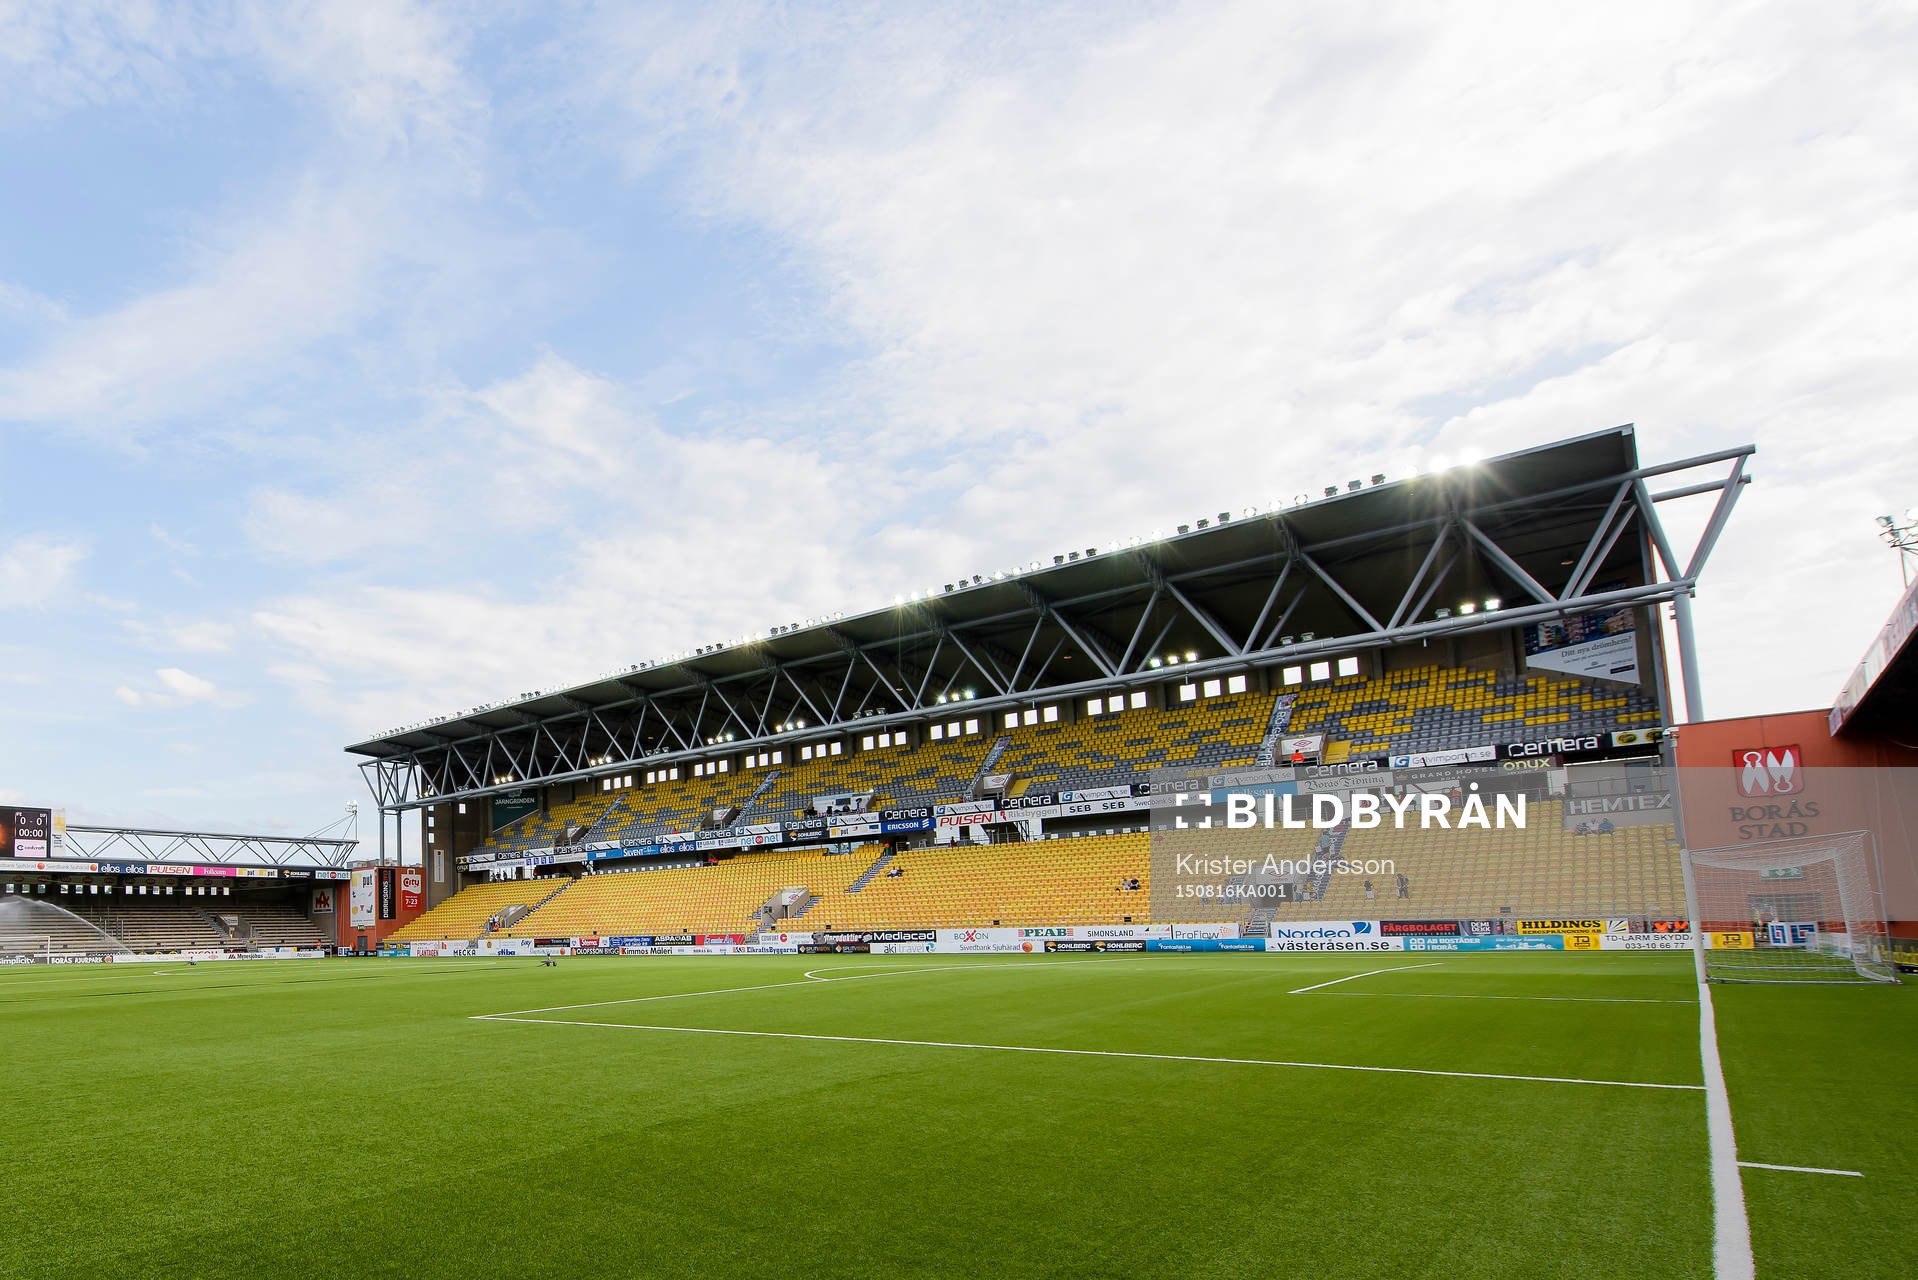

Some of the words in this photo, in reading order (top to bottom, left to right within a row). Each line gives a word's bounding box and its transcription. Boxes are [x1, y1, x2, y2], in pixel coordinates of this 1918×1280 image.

[1561, 649, 1574, 658] Ditt
[1503, 757, 1550, 770] onyx
[1412, 770, 1451, 780] GRAND
[1069, 804, 1092, 814] SEB
[1102, 801, 1125, 810] SEB
[1570, 794, 1672, 814] HEMTEX
[1008, 808, 1058, 819] Riksbyggen
[1729, 798, 1821, 822] BORÅS
[20, 816, 26, 824] 0
[36, 818, 42, 826] 0
[940, 813, 992, 827] PULSEN
[888, 822, 919, 830] ERICSSON
[1740, 822, 1808, 840] STAD
[18, 828, 43, 837] 00:00
[101, 863, 120, 874] ellos
[126, 864, 144, 874] ellos
[149, 866, 192, 874] PULSEN
[316, 890, 330, 908] MAX
[1522, 920, 1600, 929] HILDINGS
[874, 931, 934, 941] Mediacad
[954, 930, 989, 942] BOXON
[1024, 929, 1067, 937] PEAB
[1278, 928, 1350, 938] Nordea
[884, 944, 896, 954] aki
[898, 943, 924, 953] travel
[1278, 938, 1390, 950] västeråsen.se
